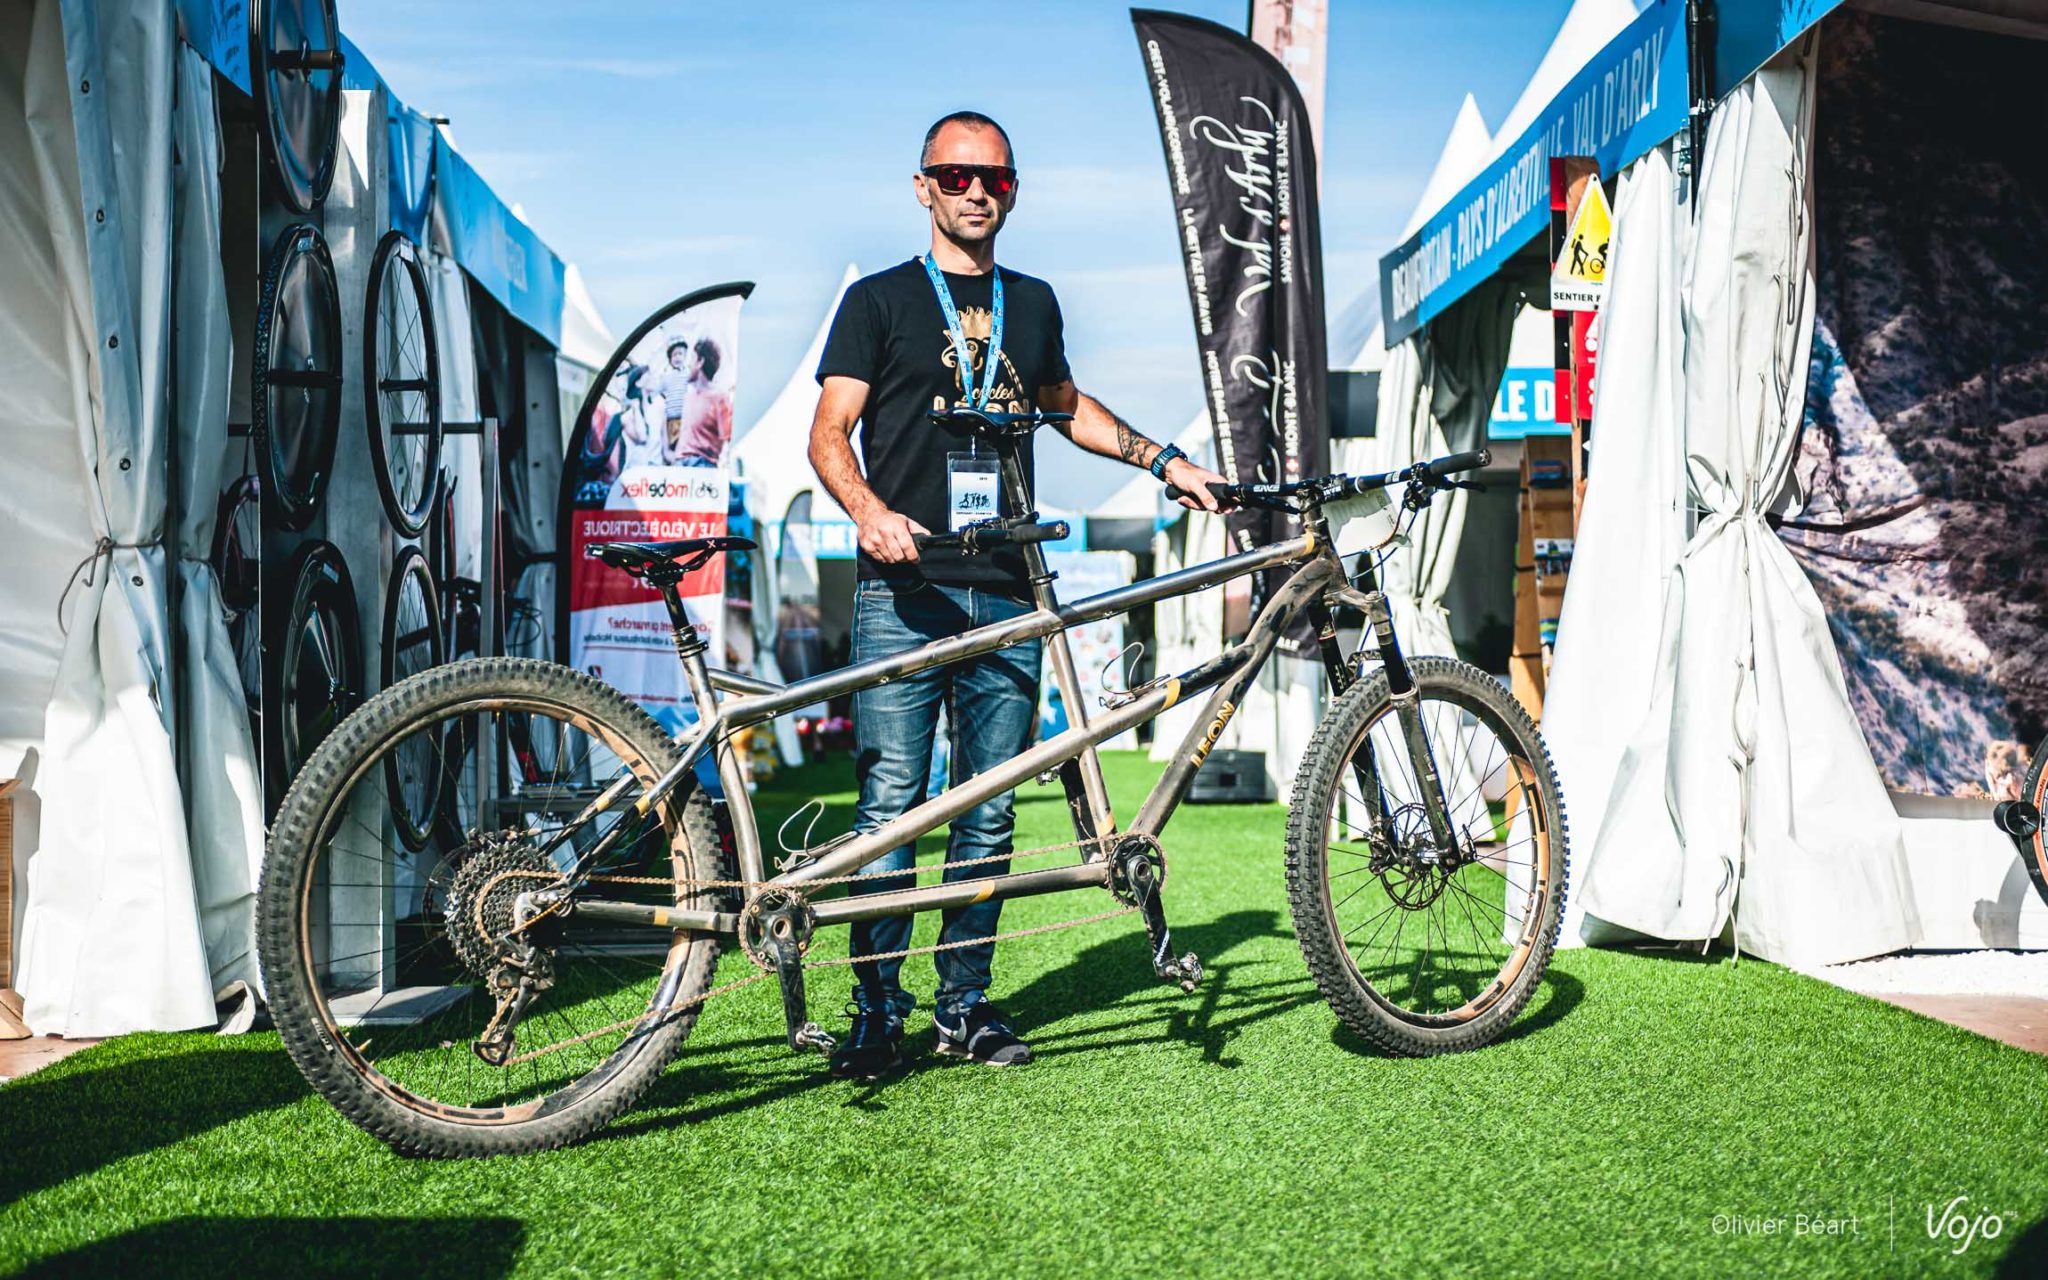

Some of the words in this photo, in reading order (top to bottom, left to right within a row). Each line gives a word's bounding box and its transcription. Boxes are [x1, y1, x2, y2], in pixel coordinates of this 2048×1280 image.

[1275, 120, 1289, 168] BLANC
[1457, 194, 1485, 271] PAYS
[1573, 84, 1598, 156] VAL
[1601, 26, 1664, 148] D'ARLY
[1277, 170, 1290, 215] MONT
[1280, 234, 1293, 283] SAVOIE
[1553, 291, 1594, 302] SENTIER
[1283, 360, 1297, 409] BLANC
[1284, 410, 1298, 456] MONT
[1190, 700, 1235, 768] LEON
